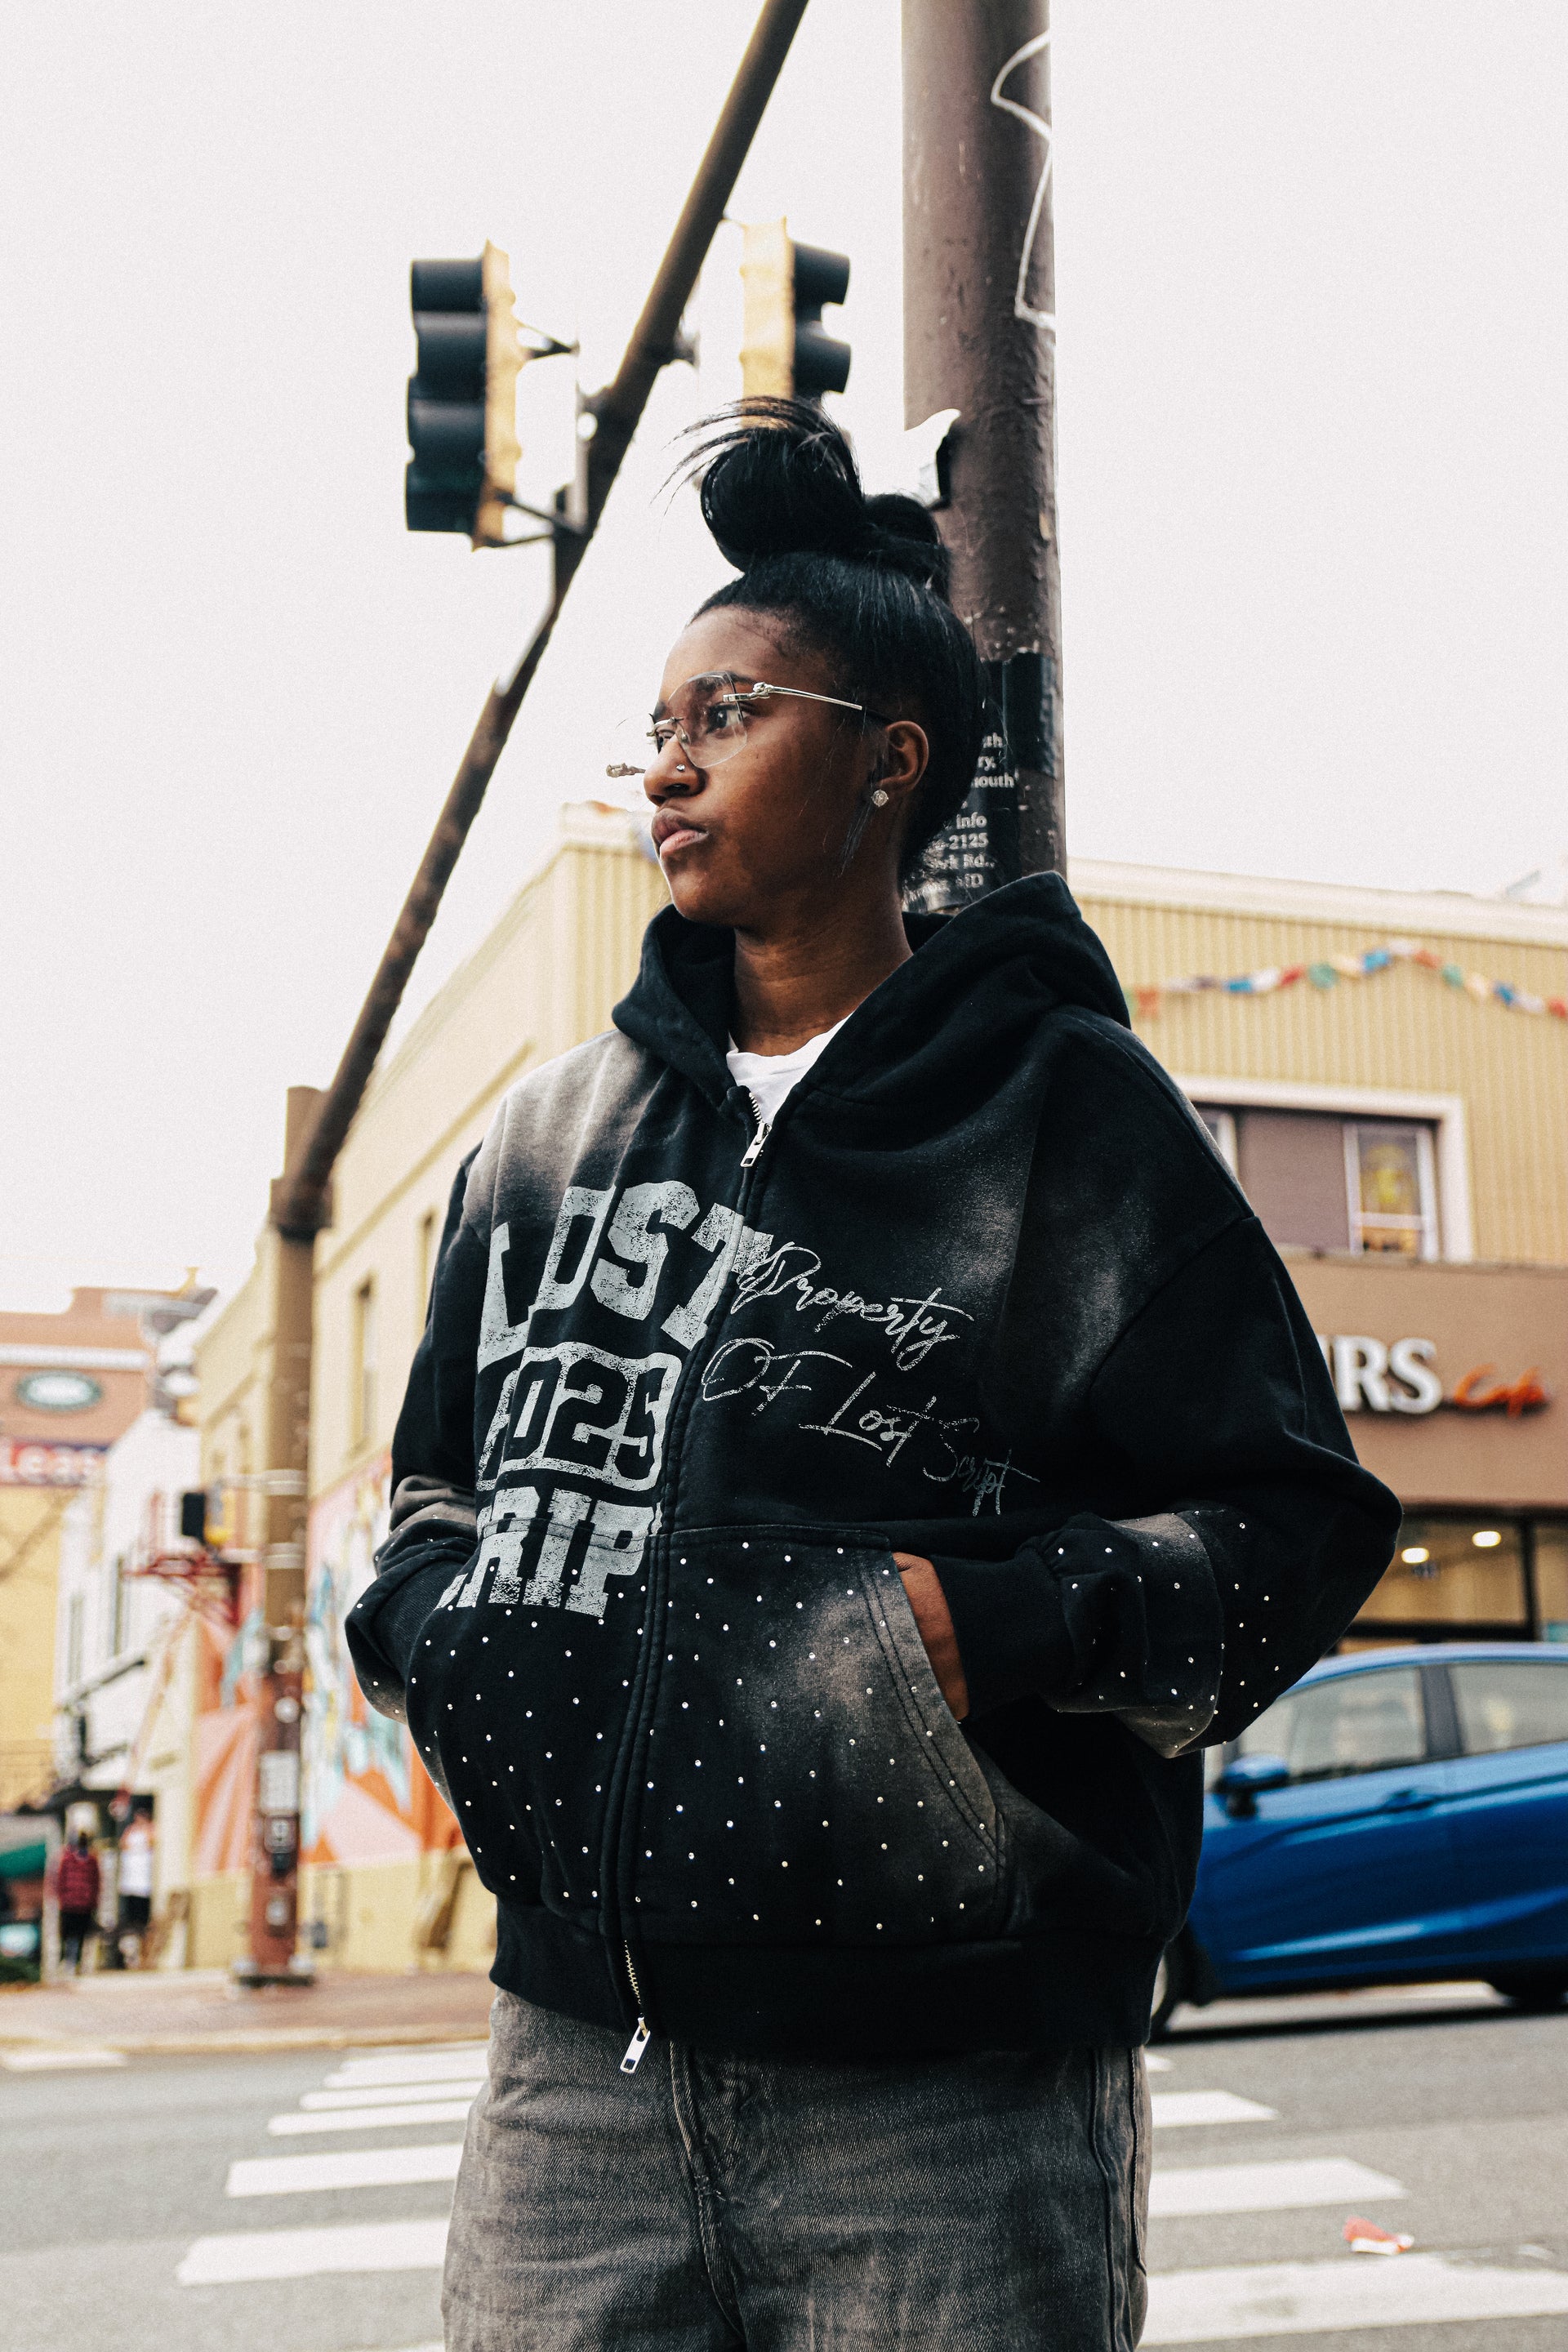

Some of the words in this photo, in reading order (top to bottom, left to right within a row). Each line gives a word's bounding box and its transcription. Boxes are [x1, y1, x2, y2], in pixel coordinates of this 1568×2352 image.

[982, 732, 1003, 748] th
[730, 1241, 974, 1371] Property
[799, 1371, 938, 1468] Lost
